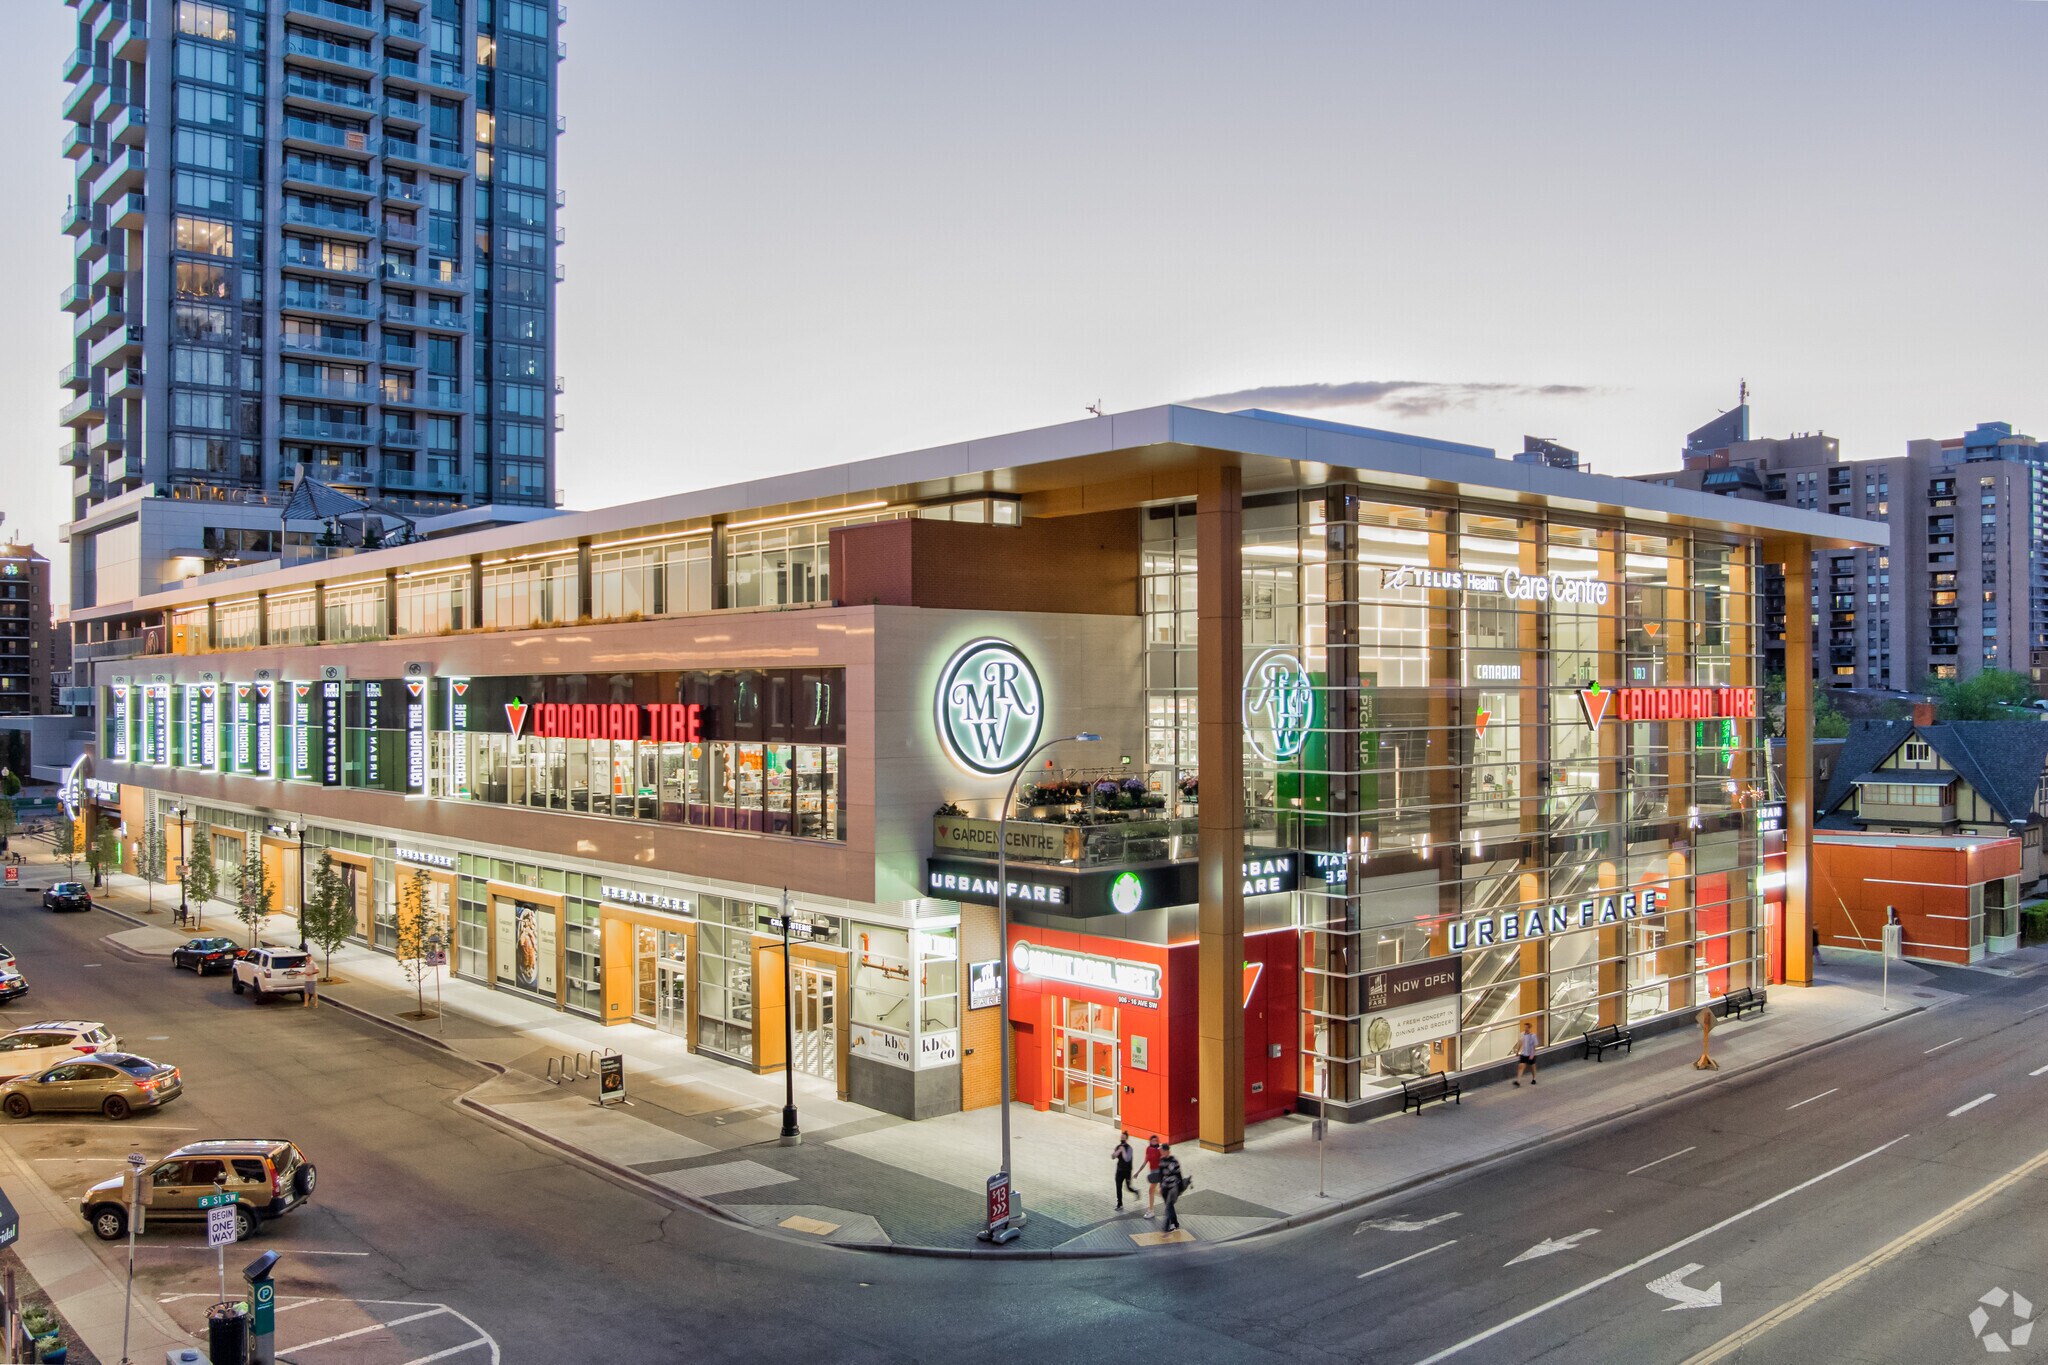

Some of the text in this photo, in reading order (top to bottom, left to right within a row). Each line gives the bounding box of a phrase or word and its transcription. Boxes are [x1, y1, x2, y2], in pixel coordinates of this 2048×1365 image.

[1414, 567, 1608, 605] TELUS Health Care Centre
[1620, 688, 1756, 720] CANADIAN TIRE
[327, 701, 336, 732] FARE
[534, 703, 701, 743] CANADIAN TIRE
[258, 703, 270, 771] CANADIAN TIRE
[1360, 695, 1369, 764] PICK UP
[408, 704, 422, 786] CANADIAN TIRE
[327, 737, 336, 781] URBAN
[1758, 819, 1778, 830] ARE
[952, 828, 1054, 850] GARDEN CENTRE
[1242, 858, 1289, 877] BAN
[931, 873, 1061, 903] URBAN FARE
[1243, 878, 1280, 895] ARE
[601, 885, 690, 912] URBAN FARE
[770, 918, 813, 933] CHAUTERIE
[1448, 889, 1656, 953] URBAN FARE
[1393, 972, 1455, 994] NOW OPEN
[1138, 999, 1148, 1008] AVE
[1149, 1000, 1158, 1009] SW
[1368, 999, 1387, 1007] FARE
[1396, 1019, 1454, 1037] DINING AND GROCERY
[1402, 1018, 1421, 1026] FRESH
[1422, 1012, 1446, 1022] CONCEPT
[898, 1050, 910, 1062] co
[940, 1048, 955, 1060] co
[201, 1194, 236, 1206] 8 ST SW
[992, 1186, 1006, 1202] $13
[212, 1209, 232, 1220] BEGIN
[212, 1220, 233, 1232] ONE
[212, 1230, 234, 1242] WAY
